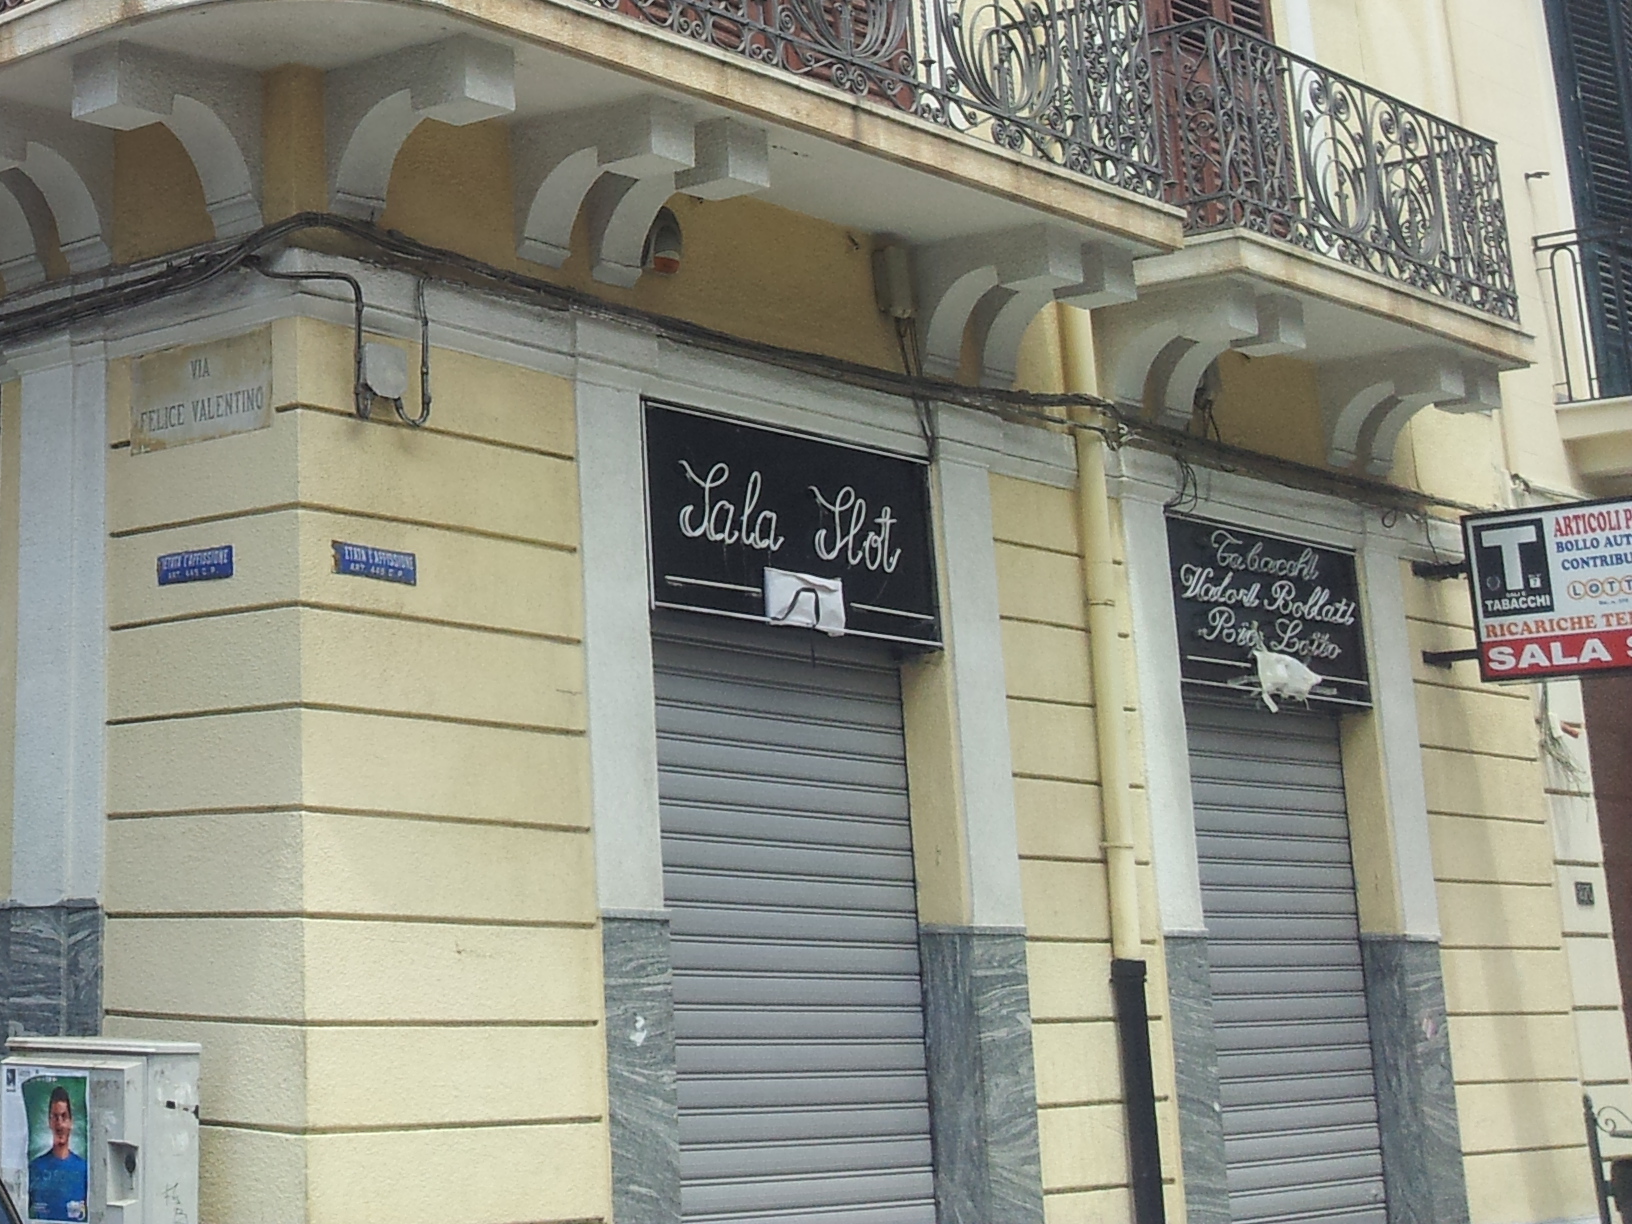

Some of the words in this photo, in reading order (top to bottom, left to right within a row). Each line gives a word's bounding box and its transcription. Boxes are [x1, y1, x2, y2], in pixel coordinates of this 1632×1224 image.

[190, 357, 211, 380] VIA
[140, 404, 186, 433] FELICE
[191, 386, 263, 422] VALENTINO
[678, 459, 785, 552] Sala
[808, 485, 902, 574] Slot
[1554, 510, 1621, 538] ARTICOLI
[1556, 538, 1600, 554] BOLLO
[1485, 595, 1551, 612] TABACCHI
[1270, 618, 1342, 660] Lotto
[1485, 614, 1597, 638] RICARICHE
[1488, 638, 1612, 670] SALA
